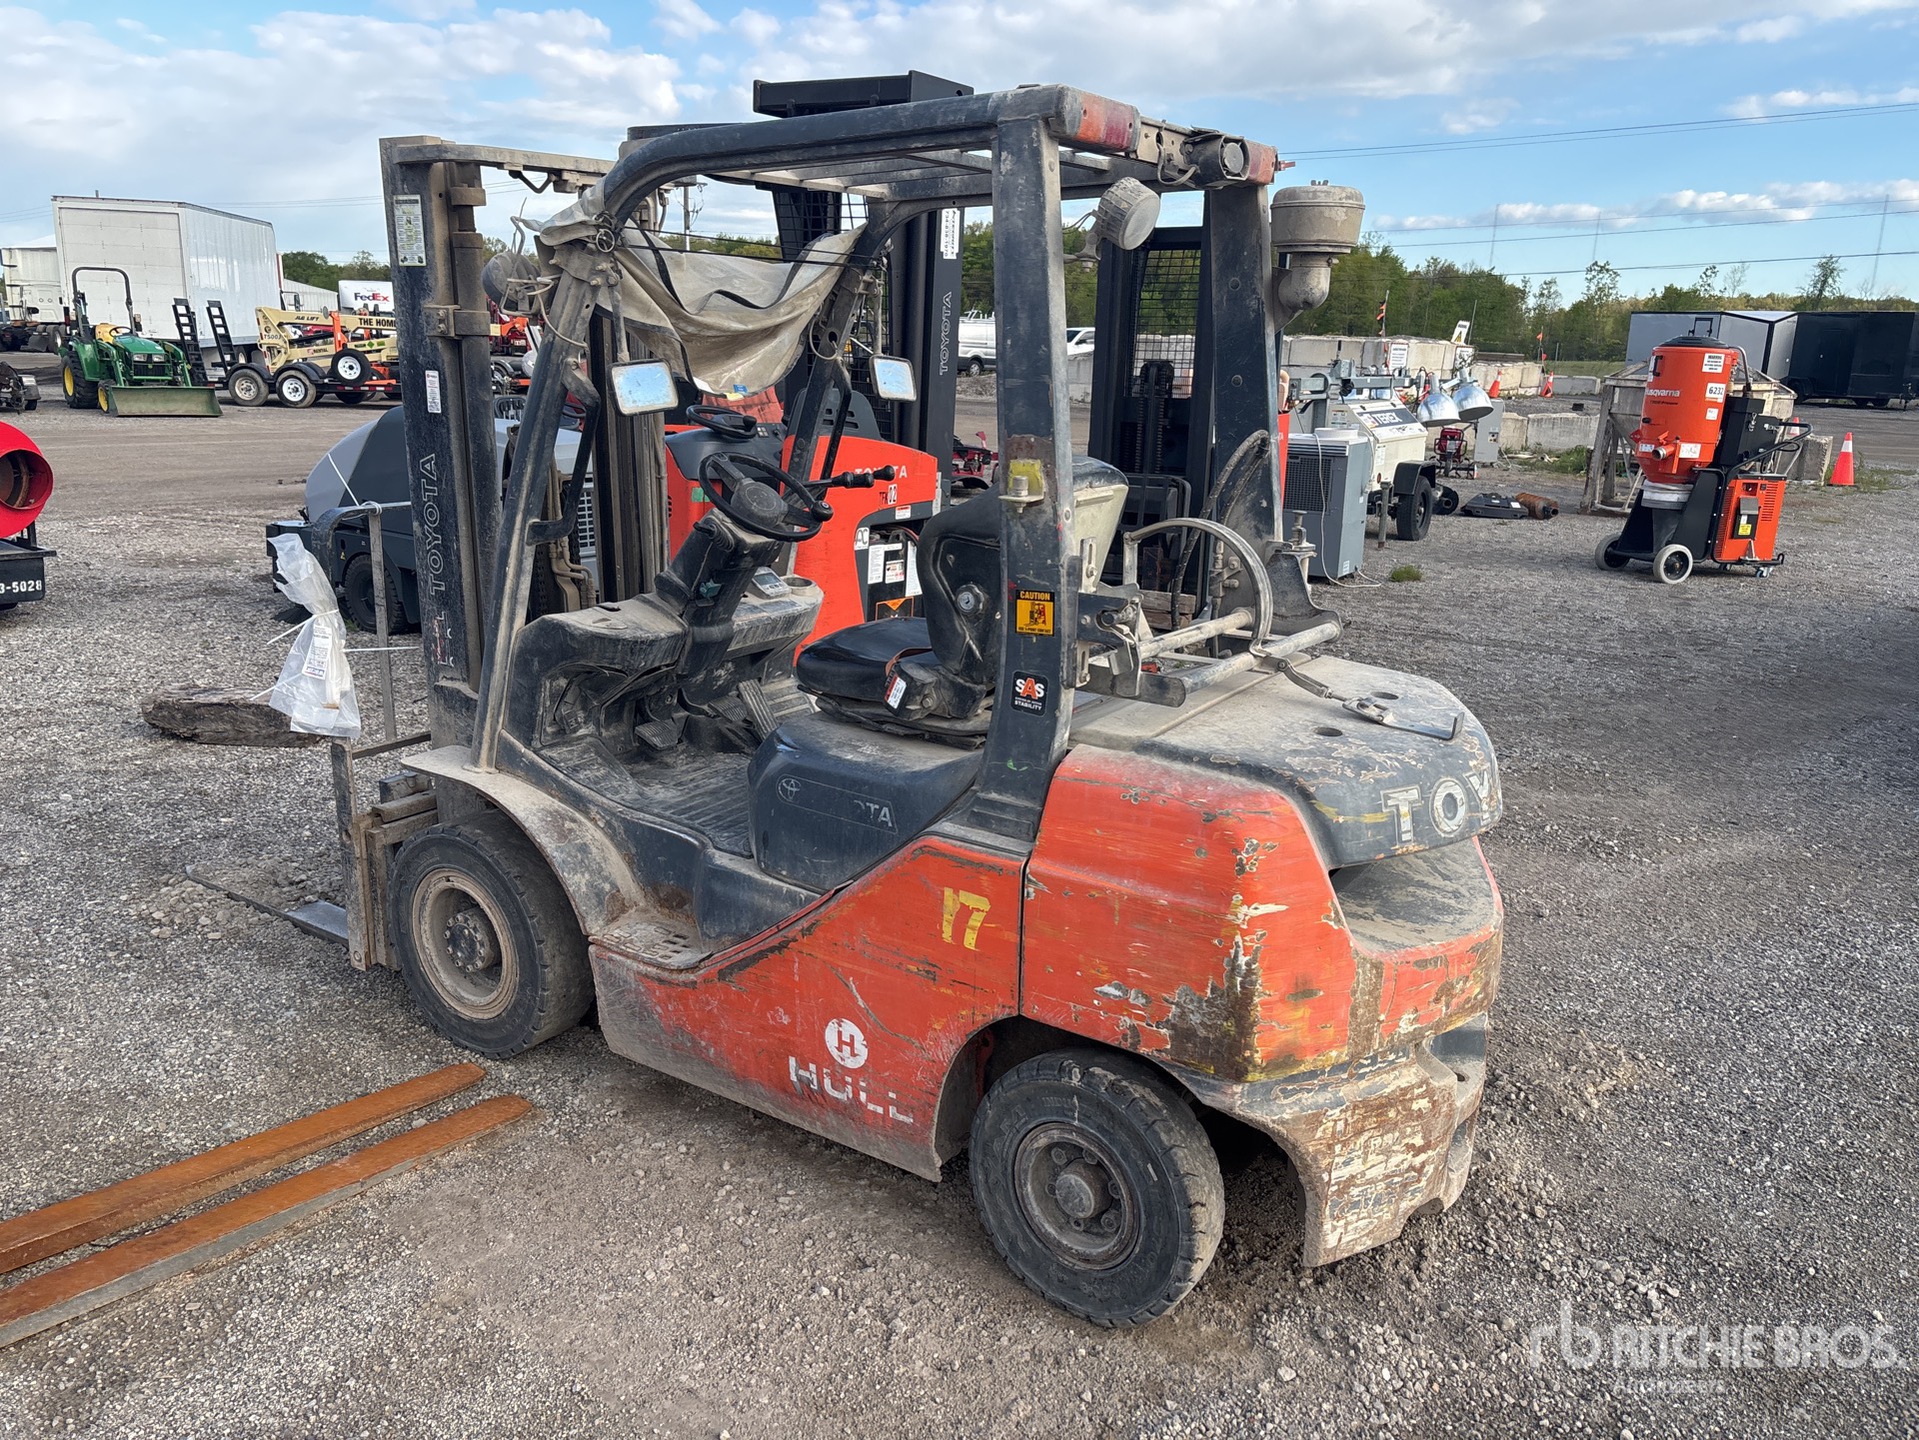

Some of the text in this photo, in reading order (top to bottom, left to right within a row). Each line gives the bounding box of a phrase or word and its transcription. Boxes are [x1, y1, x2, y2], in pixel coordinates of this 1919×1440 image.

[354, 292, 390, 302] FedEx
[358, 317, 374, 326] THE
[939, 291, 952, 375] TOYOTA
[1373, 412, 1403, 425] TEREX
[420, 453, 446, 596] TOYOTA
[1020, 591, 1051, 601] CAUTION
[1015, 677, 1045, 700] SAS
[1014, 700, 1042, 711] STABILITY
[941, 886, 991, 951] 17
[788, 1056, 914, 1125] HULL
